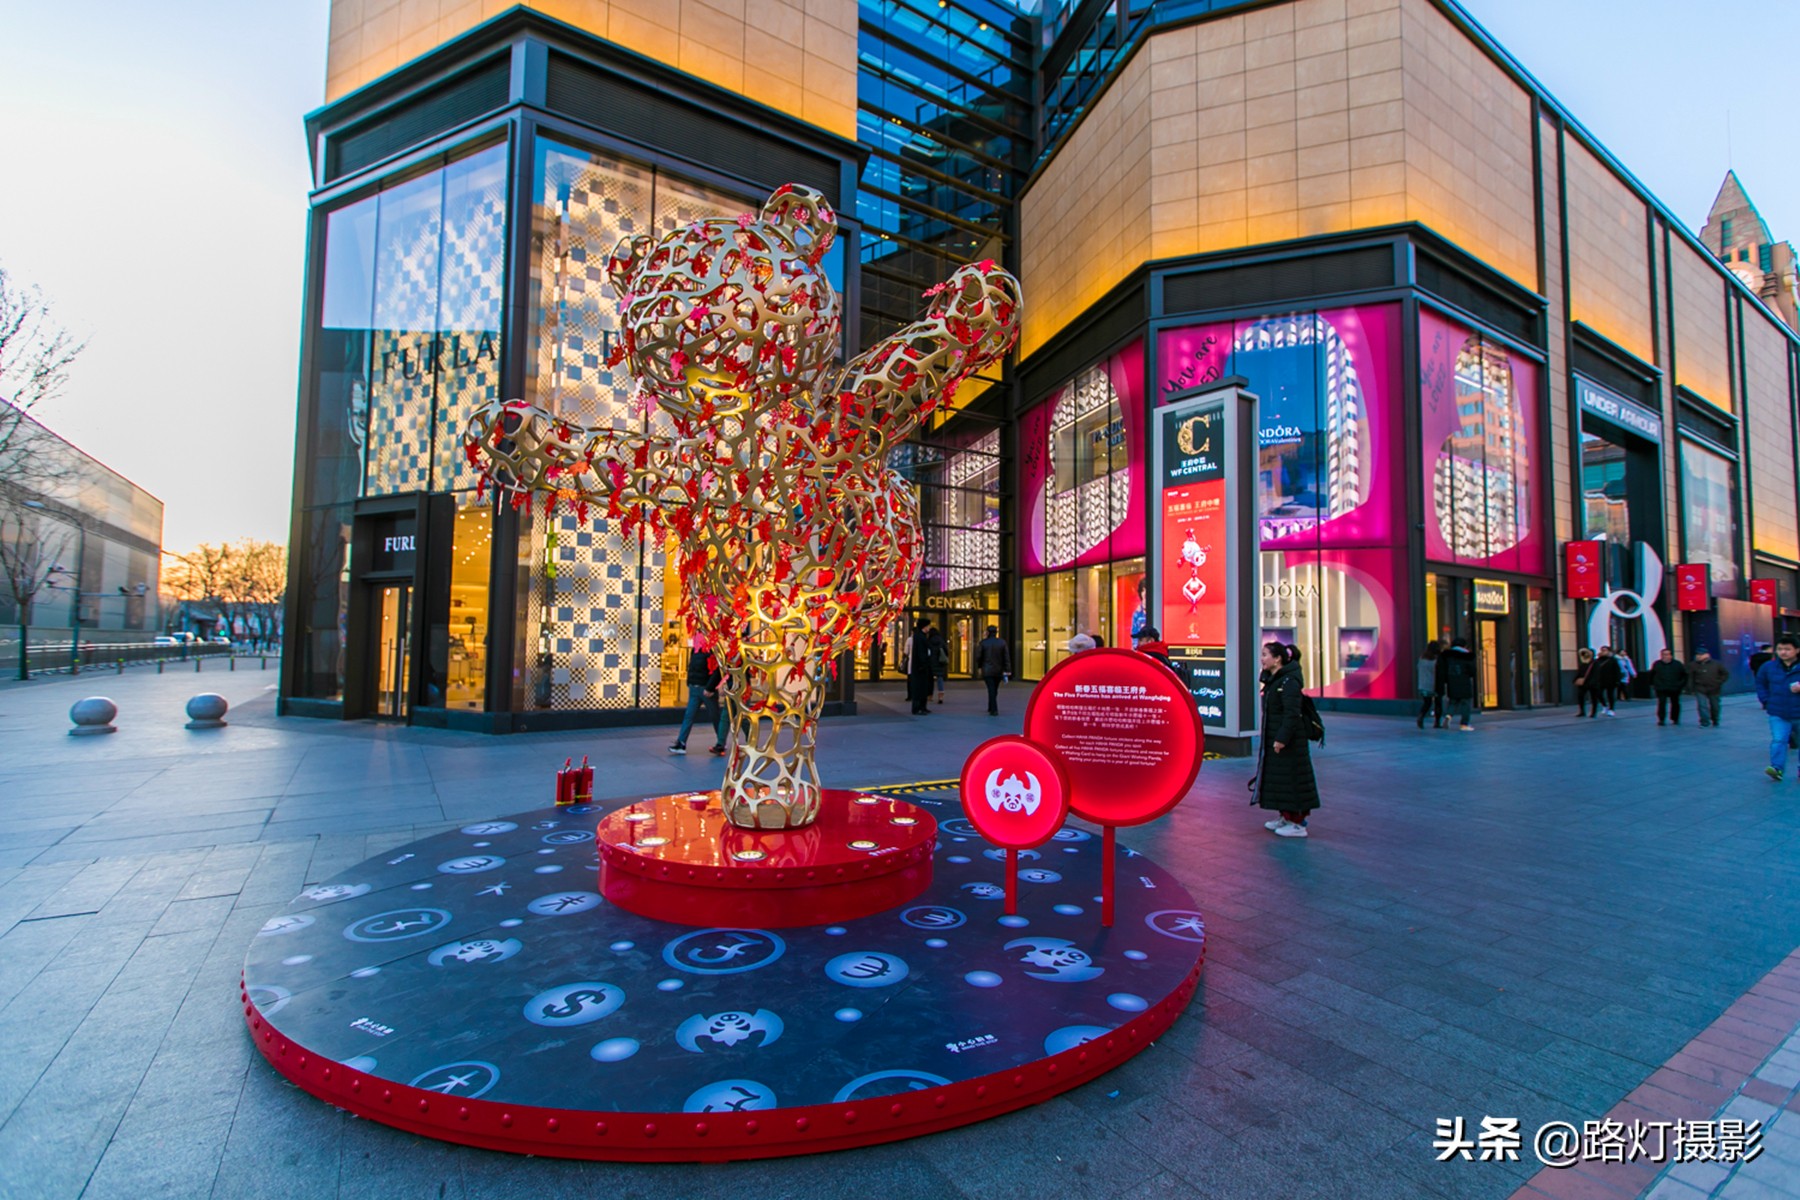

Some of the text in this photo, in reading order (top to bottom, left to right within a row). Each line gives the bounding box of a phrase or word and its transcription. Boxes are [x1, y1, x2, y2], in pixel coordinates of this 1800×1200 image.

[383, 331, 496, 386] FURLA
[1161, 335, 1217, 394] You are
[1583, 389, 1659, 438] UNDER ARMOUR
[1170, 462, 1218, 477] WF CENTRAL
[384, 535, 416, 552] FURL
[926, 596, 984, 610] CENTRAL
